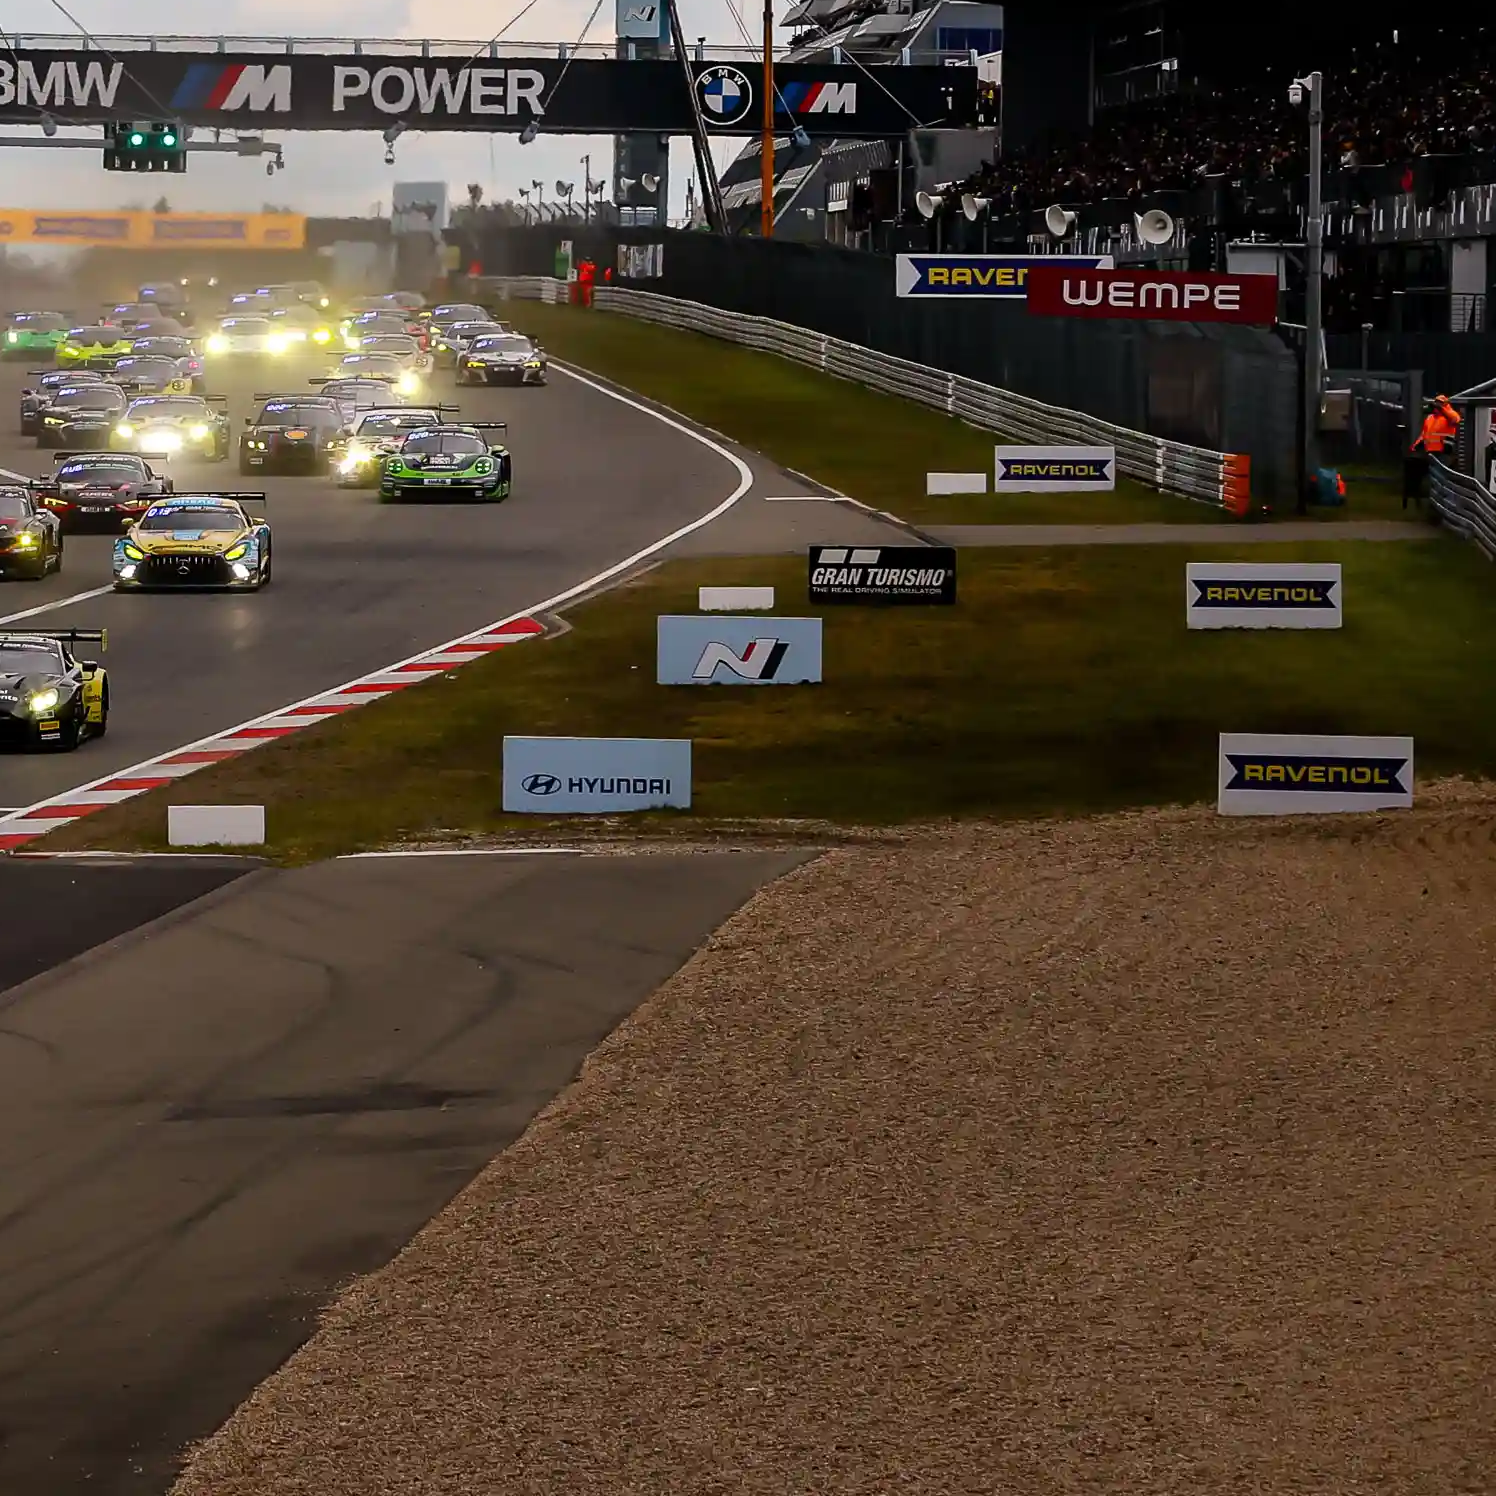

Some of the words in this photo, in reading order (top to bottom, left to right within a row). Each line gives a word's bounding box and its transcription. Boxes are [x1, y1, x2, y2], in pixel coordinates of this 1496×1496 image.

[332, 66, 545, 115] POWER
[1062, 279, 1241, 310] WEMPE
[1009, 463, 1101, 477] RAVENOL
[811, 567, 862, 586] GRAN
[866, 568, 946, 587] TURISMO
[1206, 586, 1323, 602] RAVENOL
[1243, 762, 1391, 787] RAVENOL
[567, 776, 672, 796] HYUNDAI
